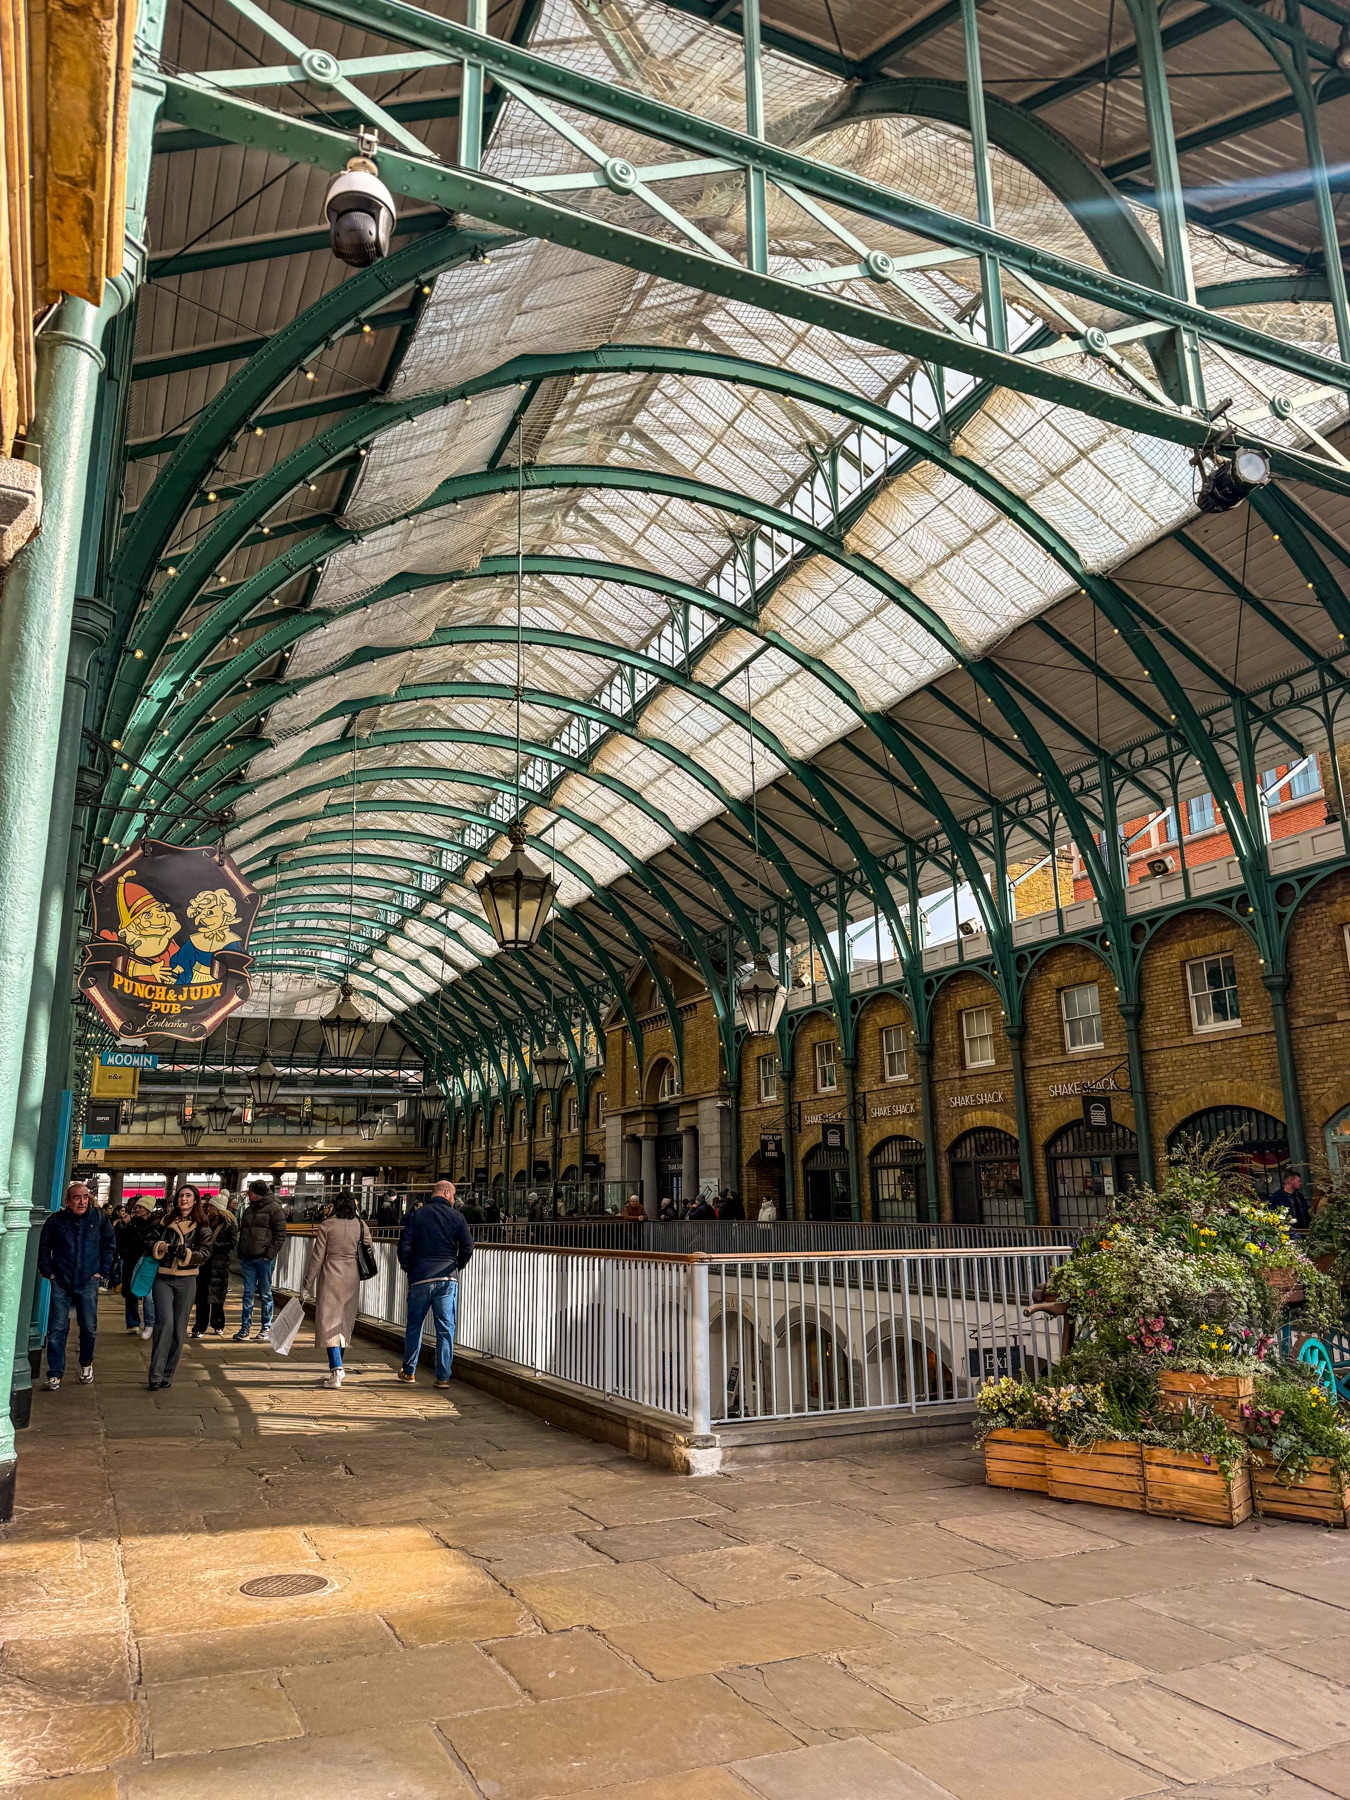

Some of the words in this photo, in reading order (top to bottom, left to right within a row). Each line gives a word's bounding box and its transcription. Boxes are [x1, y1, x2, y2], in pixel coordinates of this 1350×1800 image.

[112, 972, 167, 1000] PUNCH
[178, 983, 223, 1000] JUDY
[150, 1001, 181, 1014] PUB
[146, 1013, 188, 1028] Entrance
[107, 1054, 152, 1066] MOOMIN
[1049, 1082, 1081, 1097] SHAKE
[950, 1094, 975, 1107] SHAKE
[976, 1091, 1004, 1104] SHACK
[871, 1106, 891, 1118] SHAKE
[892, 1103, 915, 1115] SHACK
[805, 1114, 823, 1125] SHAKE
[985, 1352, 1012, 1369] Exi
